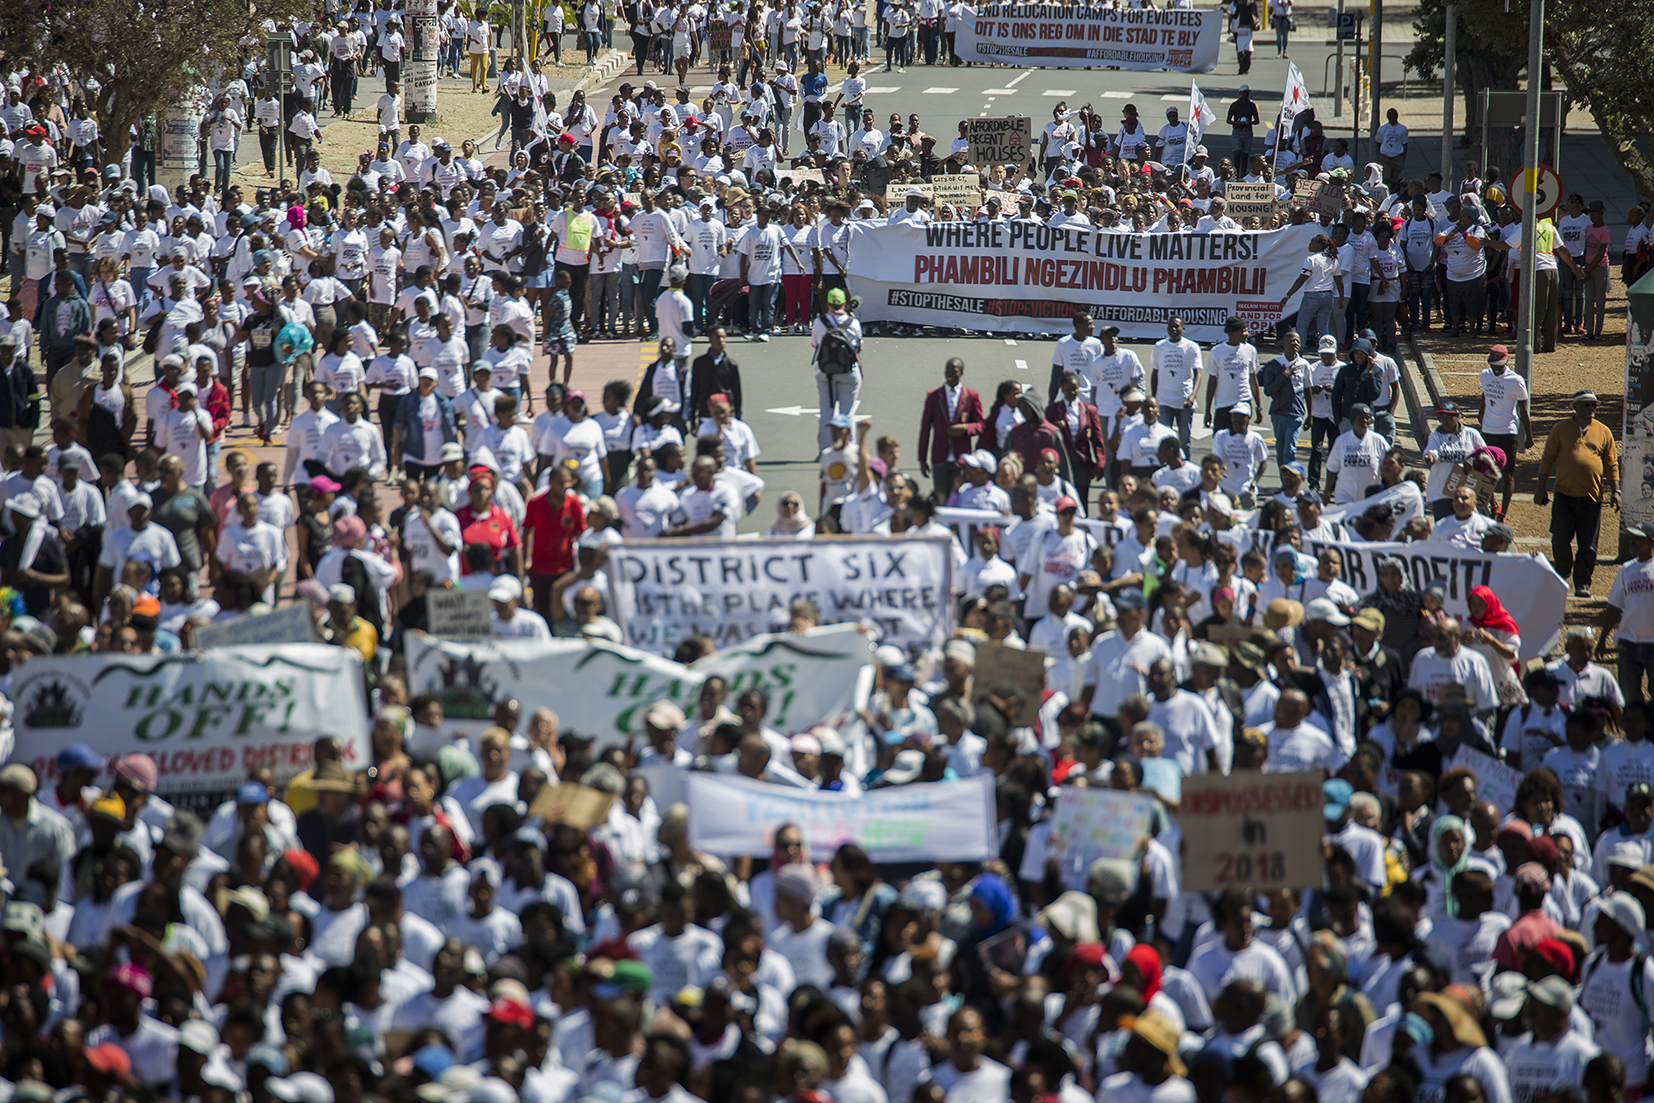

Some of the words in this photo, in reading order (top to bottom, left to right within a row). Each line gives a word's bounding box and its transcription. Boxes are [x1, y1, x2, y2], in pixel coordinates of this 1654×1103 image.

[1003, 4, 1074, 20] RELOCATION
[1076, 6, 1118, 22] CAMPS
[1121, 9, 1143, 25] FOR
[1146, 10, 1203, 27] EVICTEES
[975, 21, 995, 37] DIT
[997, 22, 1009, 38] IS
[1011, 22, 1037, 40] ONS
[1040, 23, 1063, 40] REG
[1065, 23, 1085, 41] OM
[1088, 24, 1101, 41] IN
[1103, 26, 1123, 43] DIE
[1126, 27, 1158, 45] STAD
[1159, 30, 1175, 46] TE
[1177, 30, 1200, 47] BLY
[977, 44, 1029, 57] #STOPTHESALE
[1086, 49, 1164, 63] #AFFORDABLEHOUSING
[969, 120, 1028, 134] AFFORDABLE,
[969, 133, 1005, 146] DECENT
[976, 146, 1026, 162] HOUSES
[1227, 183, 1269, 192] Provincial
[1254, 192, 1271, 200] for
[1295, 180, 1345, 200] SECTION
[1228, 204, 1274, 213] HOUSING!
[926, 222, 1003, 248] WHERE
[1009, 221, 1090, 254] PEOPLE
[1095, 234, 1143, 260] LIVE
[1149, 234, 1259, 261] MATTERS!
[914, 255, 1020, 286] PHAMBILI
[1024, 257, 1148, 293] NGEZINDLU
[1152, 267, 1267, 296] PHAMBILI!
[891, 291, 985, 314] #STOPTHESALE
[986, 300, 1086, 318] #STOPEVICTIONS
[1235, 311, 1261, 320] LAND
[1263, 312, 1282, 320] FOR
[829, 586, 936, 611] WHERE
[607, 661, 797, 697] HADS
[123, 676, 297, 709] HANDS
[133, 700, 297, 744] OFF!
[1214, 851, 1286, 885] 2018
